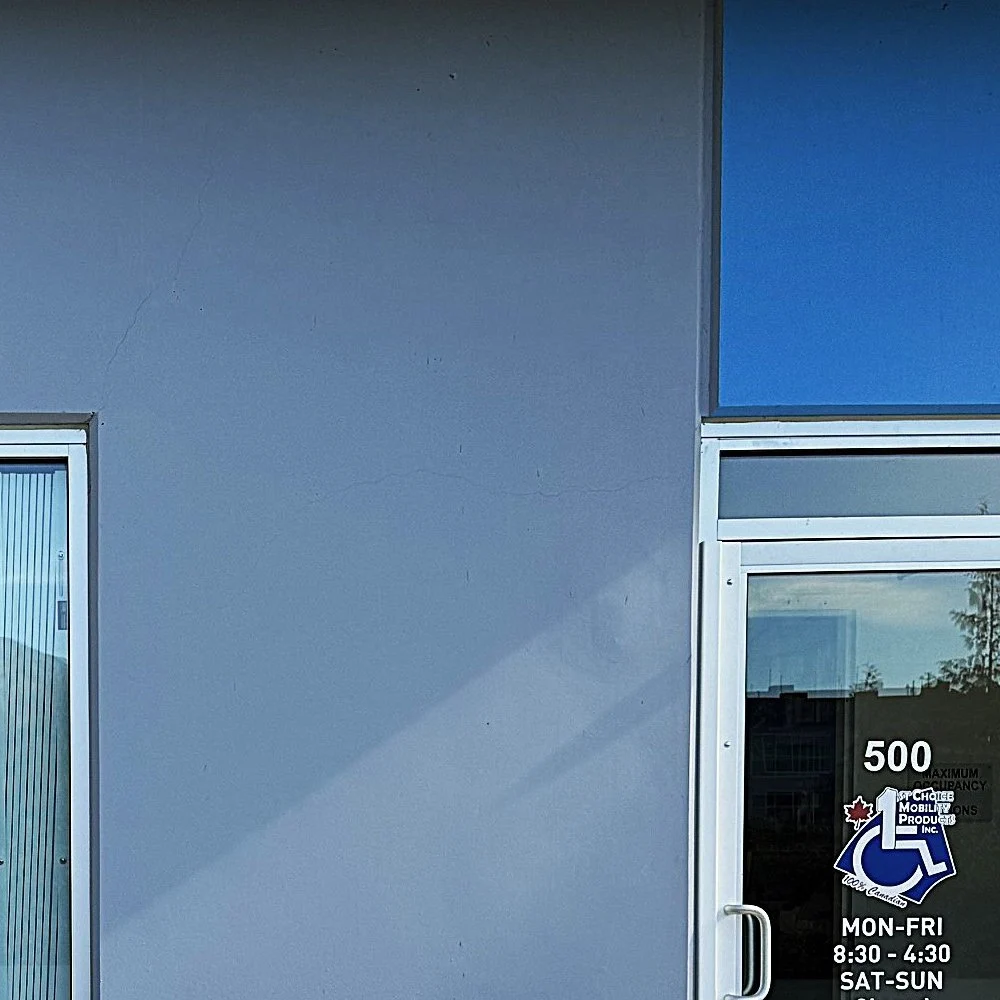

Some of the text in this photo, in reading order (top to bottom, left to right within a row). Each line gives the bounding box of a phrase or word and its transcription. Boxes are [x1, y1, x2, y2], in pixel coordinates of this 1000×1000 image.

[864, 741, 931, 772] 500
[843, 875, 906, 907] 100% Canadian
[842, 917, 943, 937] MON-FRI
[833, 944, 881, 963] 8:30
[903, 944, 951, 963] 4:30
[840, 971, 943, 991] SAT-SUN
